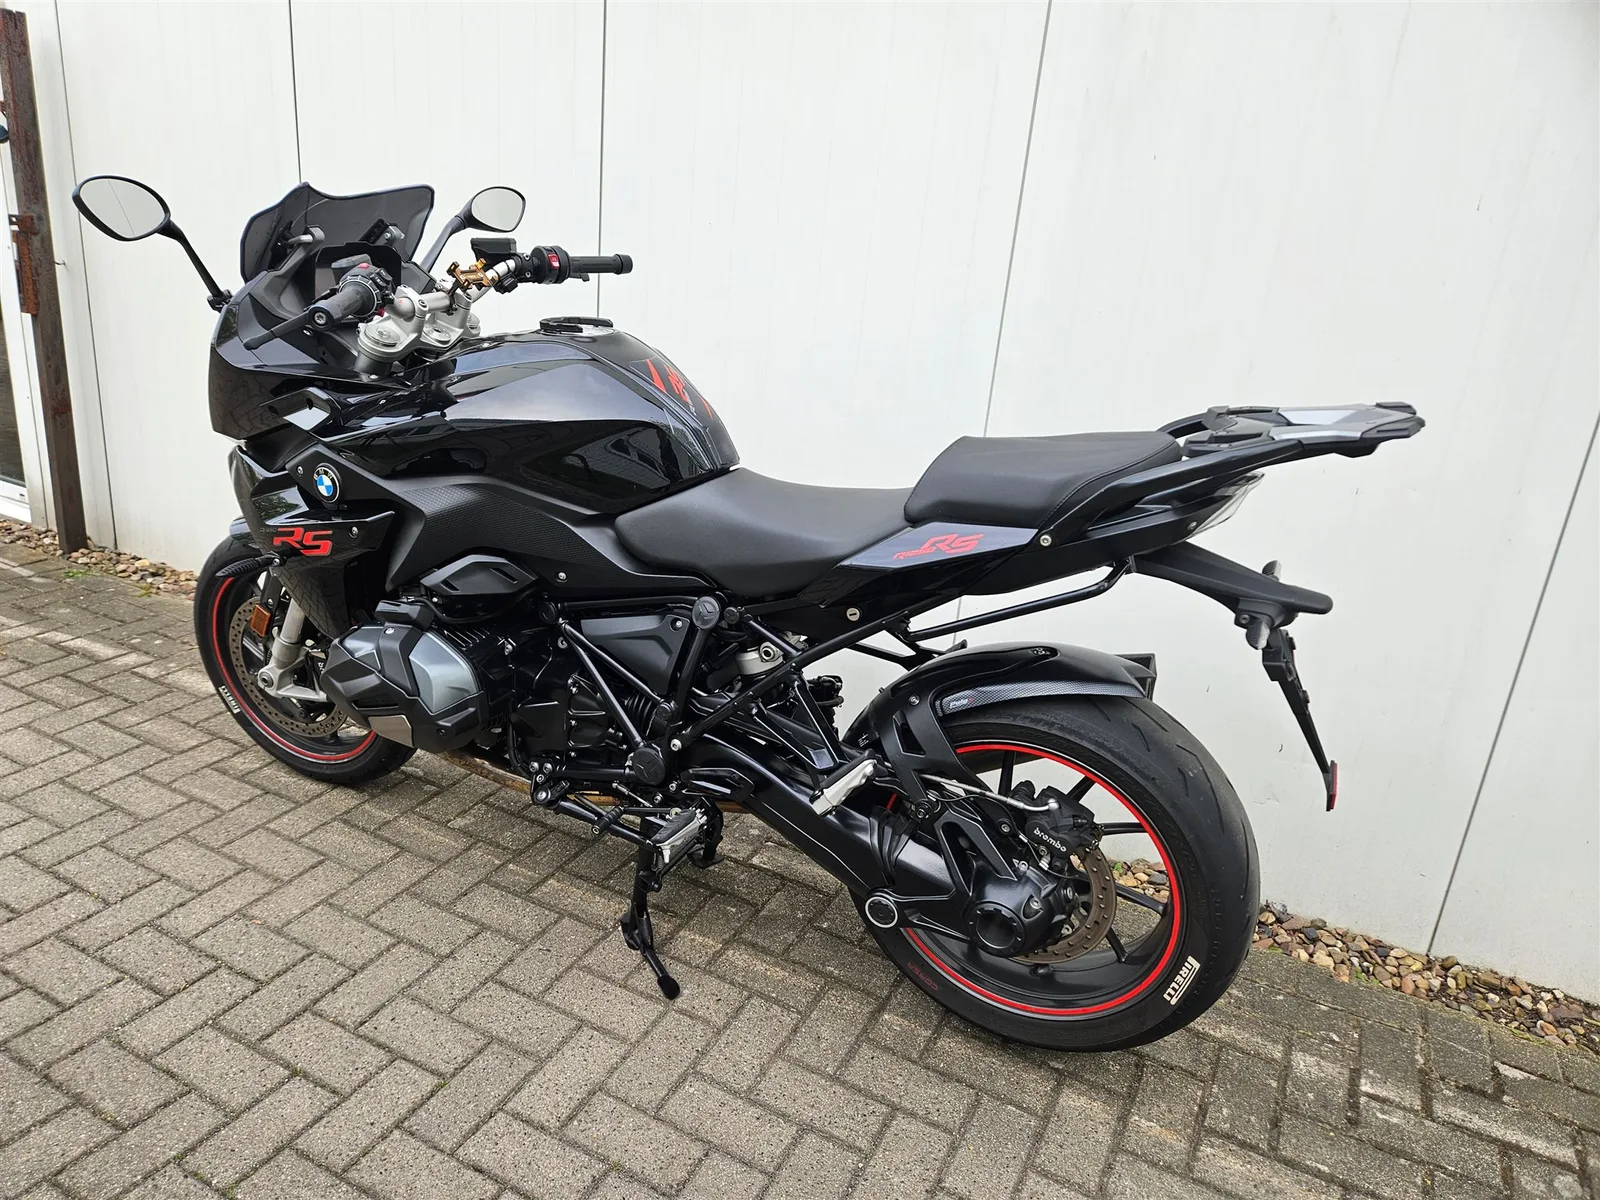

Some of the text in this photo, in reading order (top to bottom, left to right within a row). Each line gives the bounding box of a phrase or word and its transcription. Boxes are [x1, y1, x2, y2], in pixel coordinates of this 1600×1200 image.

[273, 527, 333, 556] RS
[920, 533, 984, 554] RS
[1033, 827, 1067, 852] brembo
[1163, 955, 1201, 1005] PIRELLI
